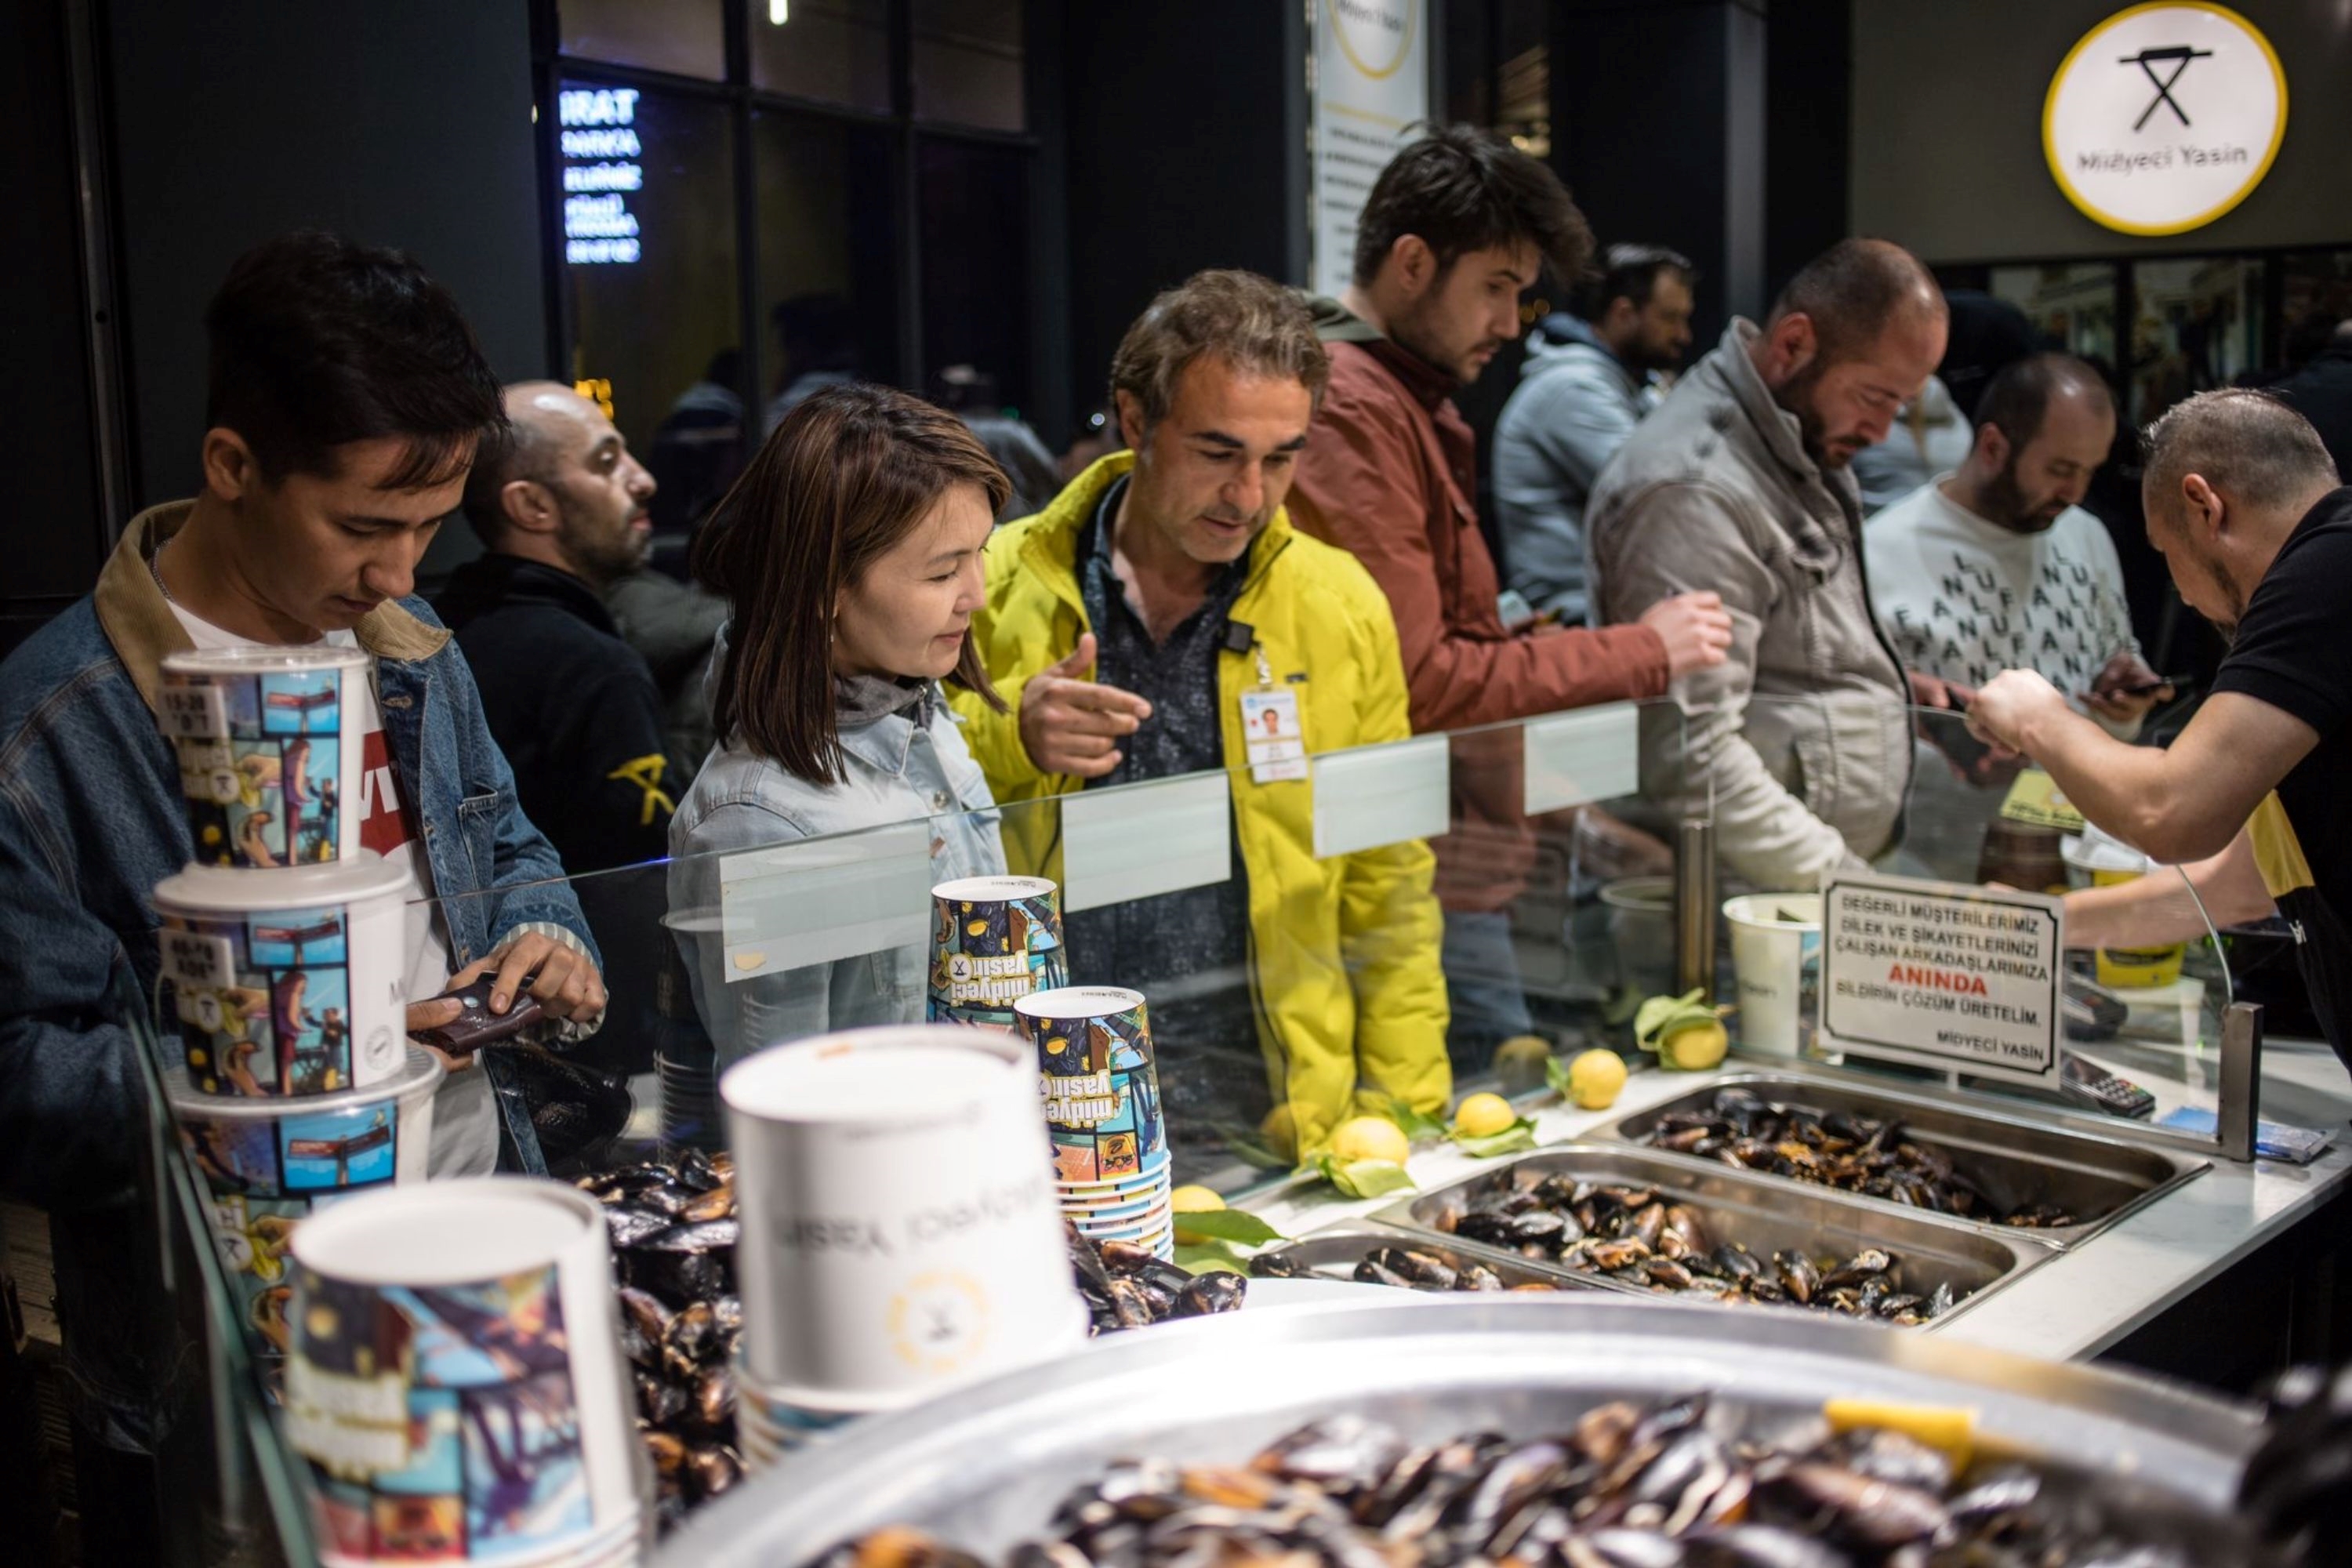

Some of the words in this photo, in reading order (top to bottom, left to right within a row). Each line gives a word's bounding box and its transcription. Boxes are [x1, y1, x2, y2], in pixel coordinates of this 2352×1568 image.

[2078, 145, 2172, 177] Midyeci
[2180, 141, 2248, 165] Yasin
[1842, 894, 1906, 917] DEĞERLİ
[1911, 901, 2039, 935] MÜŞTERİLERİMİZ
[1842, 916, 1882, 937] DİLEK
[1889, 925, 1907, 941] VE
[1912, 925, 2038, 959] ŞİKAYETLERİNİZİ
[974, 950, 1027, 977] yasin
[1835, 935, 1898, 959] ÇALIŞAN
[1902, 947, 2049, 982] ARKADAŞLARIMIZA
[951, 977, 1030, 1006] midyeci
[1836, 979, 1897, 1002] BİLDİRİN
[1902, 989, 1955, 1012] ÇÖZÜM
[1889, 963, 1987, 997] ANINDA
[1937, 1029, 1998, 1053] MİDYECİ
[2002, 1041, 2044, 1062] YASİN
[1052, 1069, 1112, 1096] yasin
